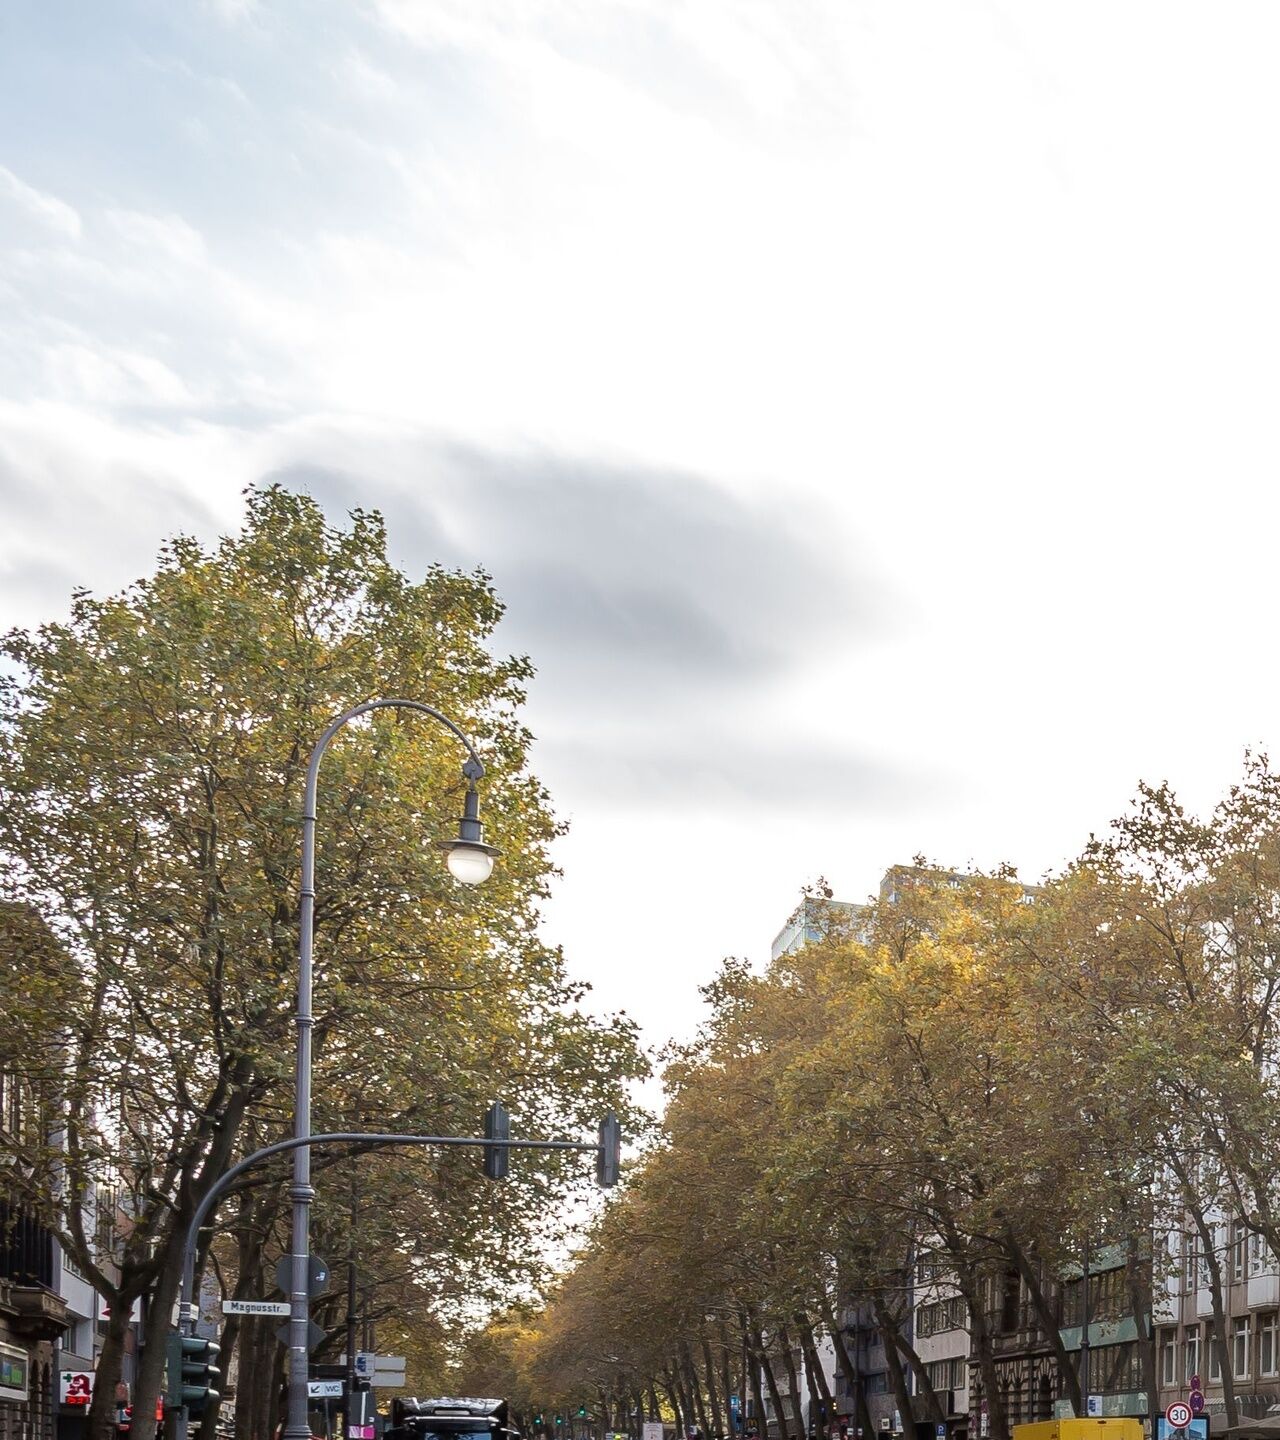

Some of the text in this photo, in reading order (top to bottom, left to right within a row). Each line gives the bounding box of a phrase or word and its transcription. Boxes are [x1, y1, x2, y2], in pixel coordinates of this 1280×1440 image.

[231, 1302, 283, 1313] Magnusstr.
[326, 1385, 340, 1393] WC
[1172, 1410, 1187, 1420] 30
